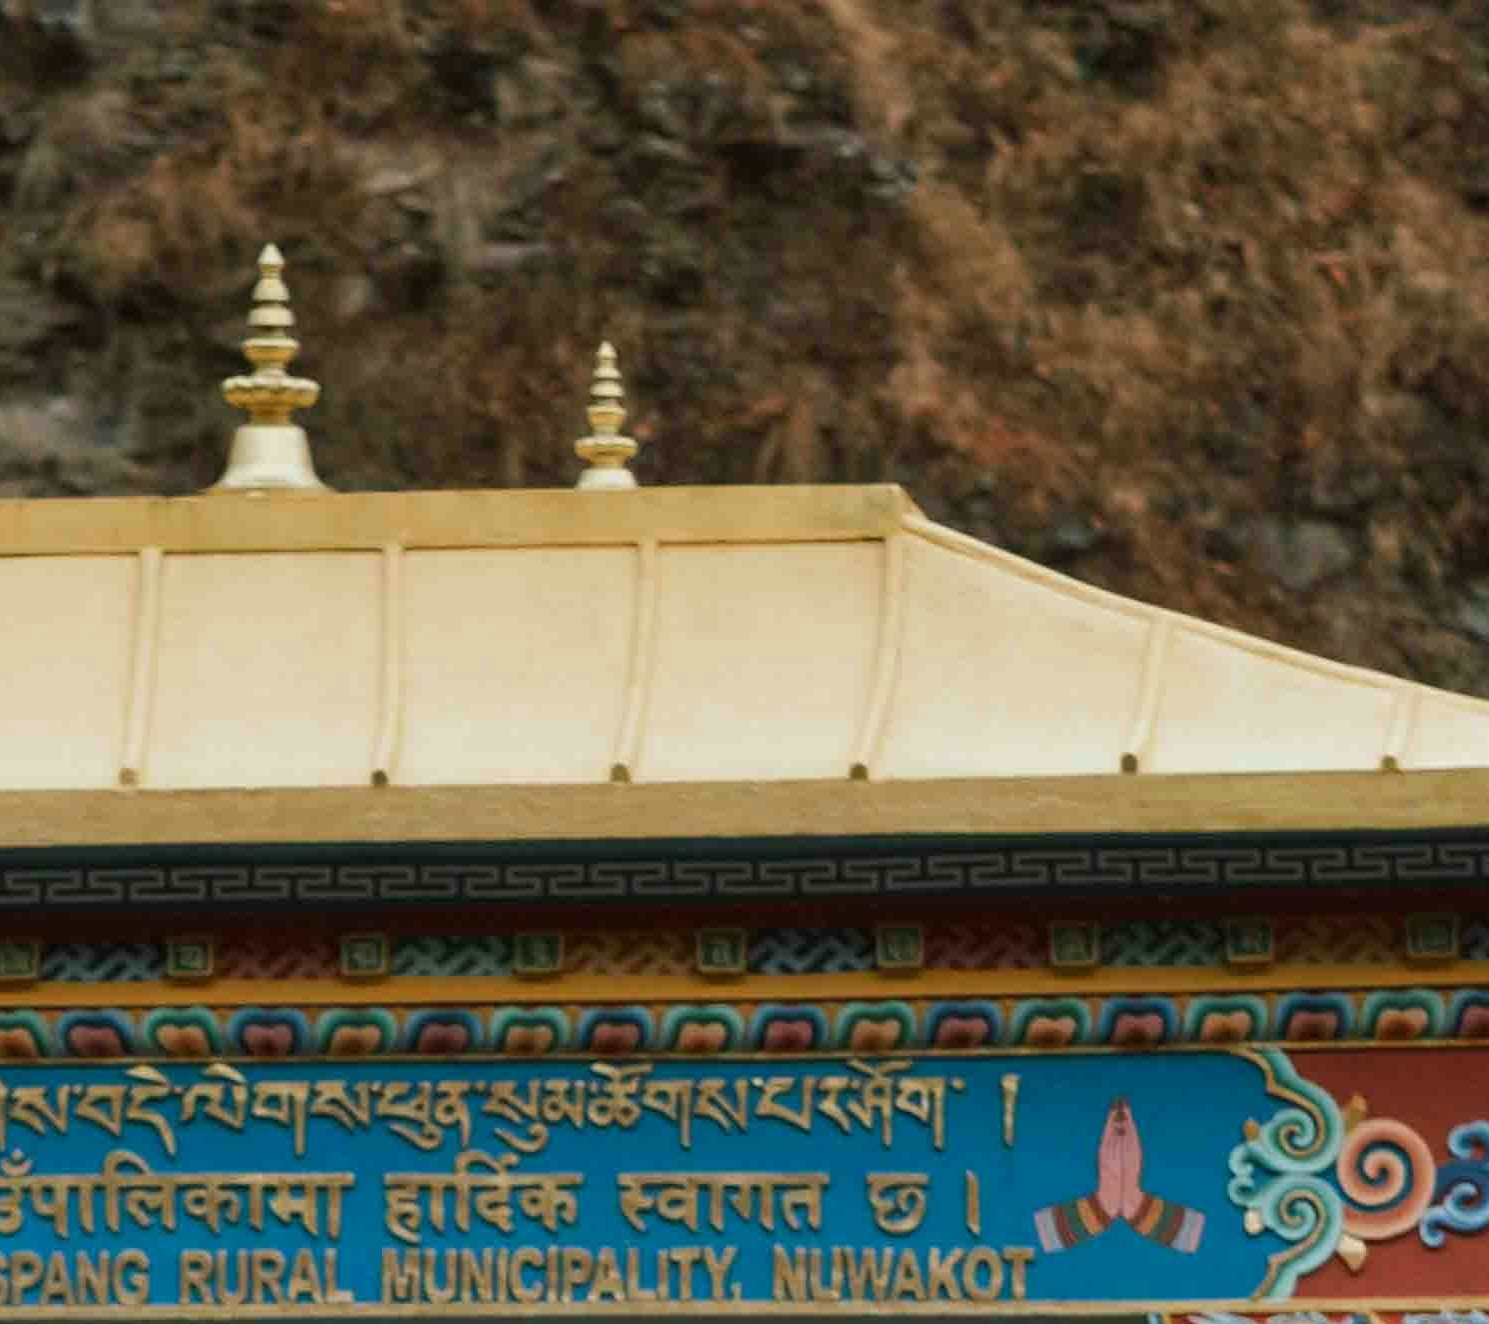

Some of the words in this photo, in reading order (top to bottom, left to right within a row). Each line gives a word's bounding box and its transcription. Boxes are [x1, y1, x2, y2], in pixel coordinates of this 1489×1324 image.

[383, 1150, 584, 1243] हार्दिक
[617, 1172, 831, 1235] स्वागत
[866, 1172, 929, 1235] छ
[178, 1247, 355, 1307] RURAL
[771, 1245, 1036, 1302] NUWAKOT
